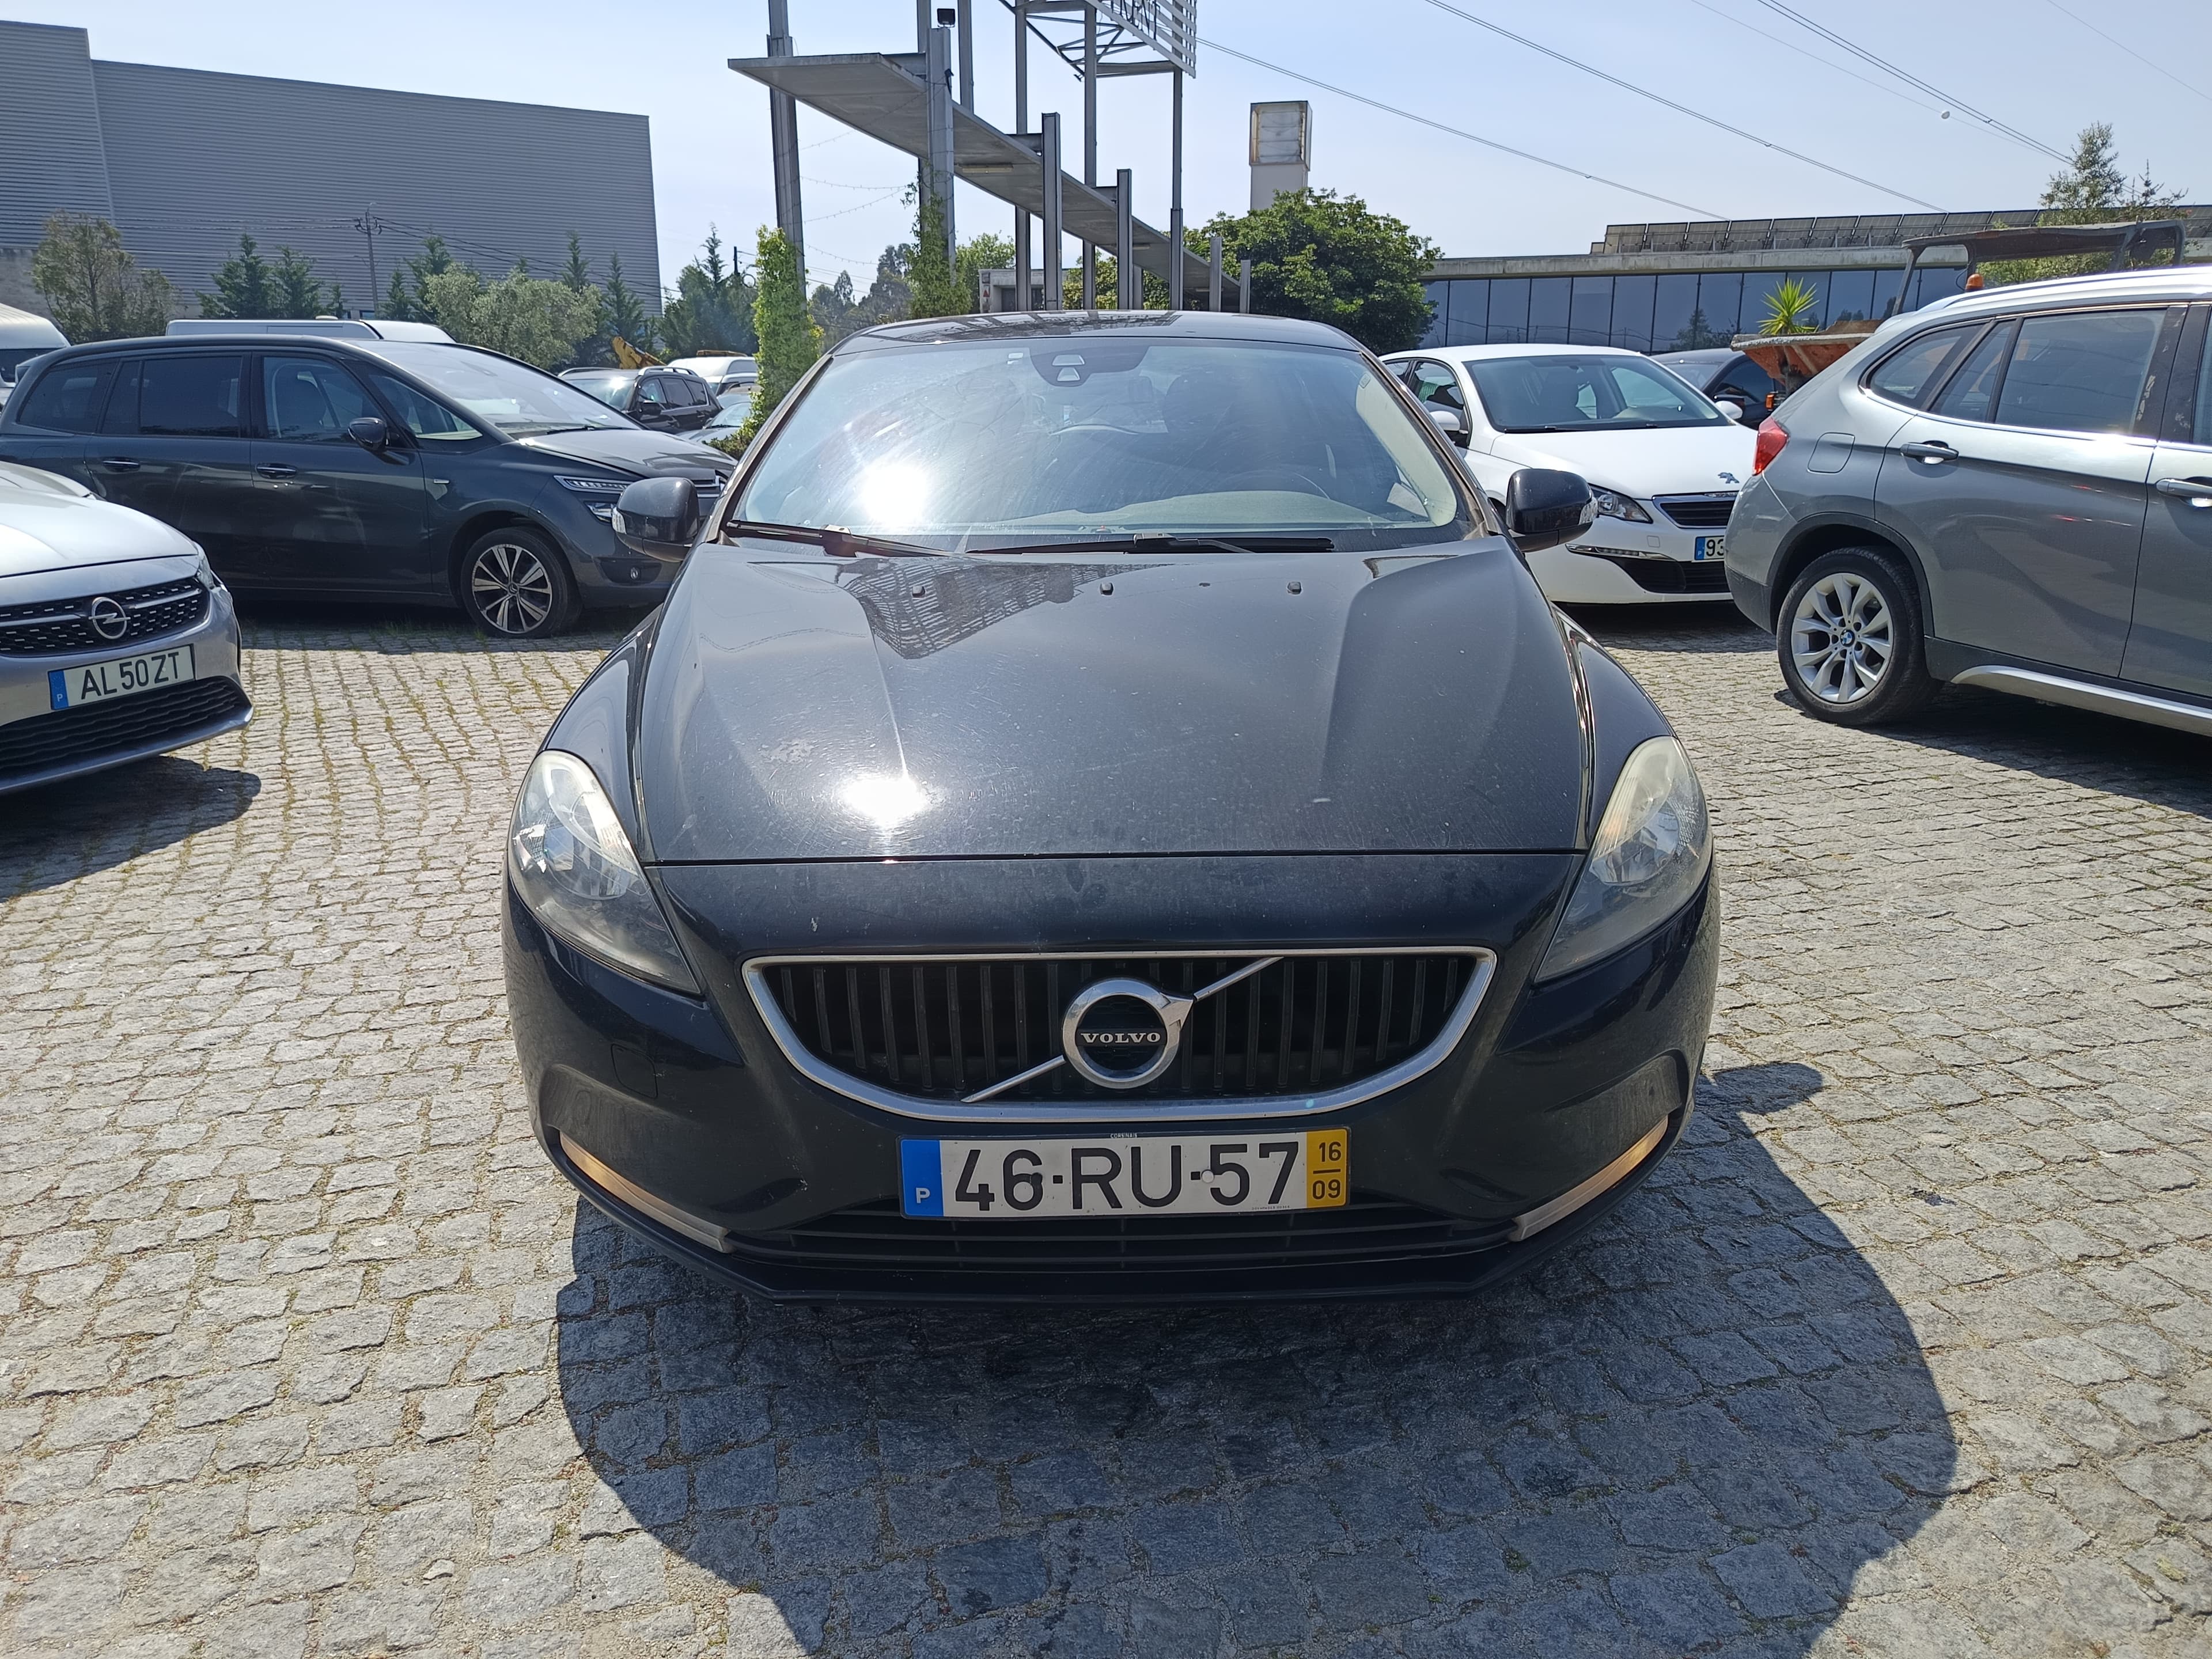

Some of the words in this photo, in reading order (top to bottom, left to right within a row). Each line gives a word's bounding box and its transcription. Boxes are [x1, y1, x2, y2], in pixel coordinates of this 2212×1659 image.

[56, 693, 63, 702] P
[1081, 1032, 1161, 1043] VOLVO
[1319, 1141, 1342, 1162] 16
[915, 1187, 930, 1204] P
[1312, 1179, 1341, 1199] 09
